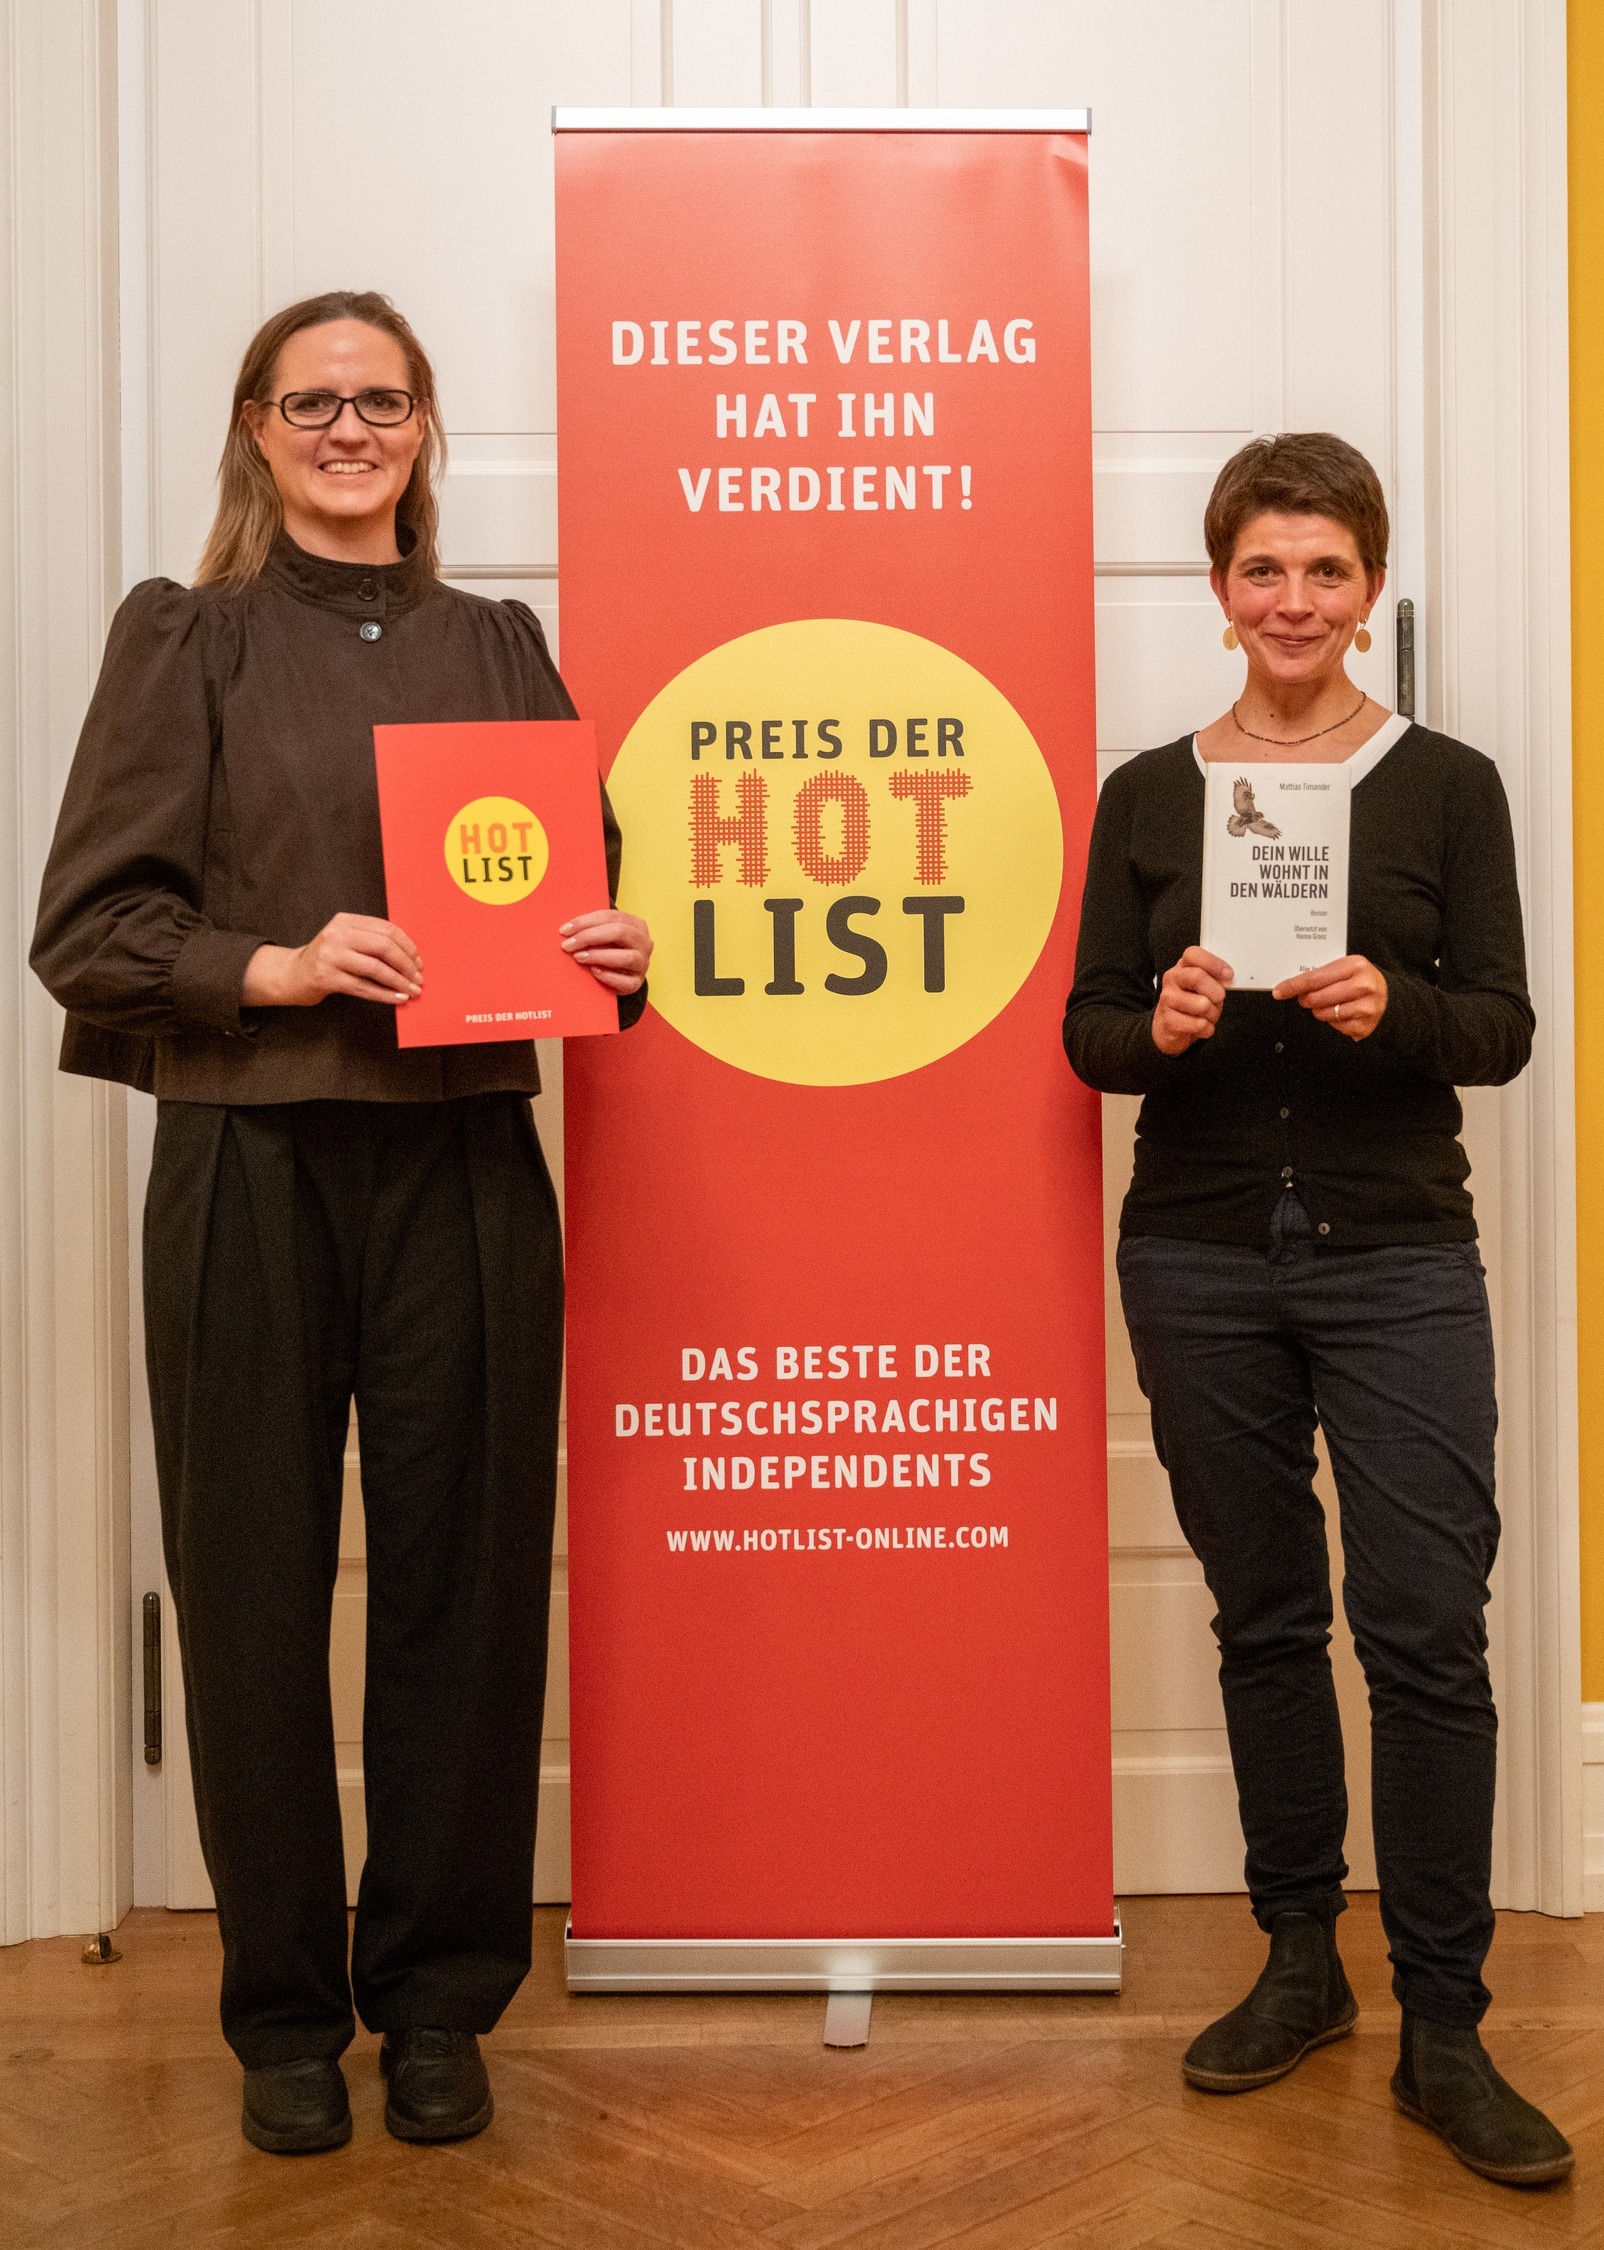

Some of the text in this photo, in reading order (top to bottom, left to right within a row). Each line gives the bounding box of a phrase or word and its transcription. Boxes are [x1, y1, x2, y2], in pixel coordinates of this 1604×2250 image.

[612, 317, 1036, 365] DIESER VERLAG
[716, 392, 934, 438] HAT IHN
[678, 465, 973, 512] VERDIENT!
[691, 718, 965, 760] PREIS DER
[1279, 782, 1330, 791] Mattias Timander
[460, 822, 533, 854] HOT
[688, 768, 973, 888] HOT
[463, 856, 532, 883] LIST
[1252, 845, 1329, 861] DEIN WILLE
[1230, 880, 1328, 899] DEN WÄLDERN
[1260, 865, 1328, 880] WOHNT IN
[1310, 909, 1328, 917] Roman
[693, 896, 965, 997] LIST
[465, 1009, 552, 1023] PREIS DER HOTLIST
[682, 1344, 991, 1380] DAS BESTE DER
[615, 1398, 1057, 1437] DEUTSCHSPRACHIGEN
[683, 1453, 991, 1490] INDEPENDENTS
[667, 1526, 1009, 1552] WWW.HOTLIST-ONLINE.COM
